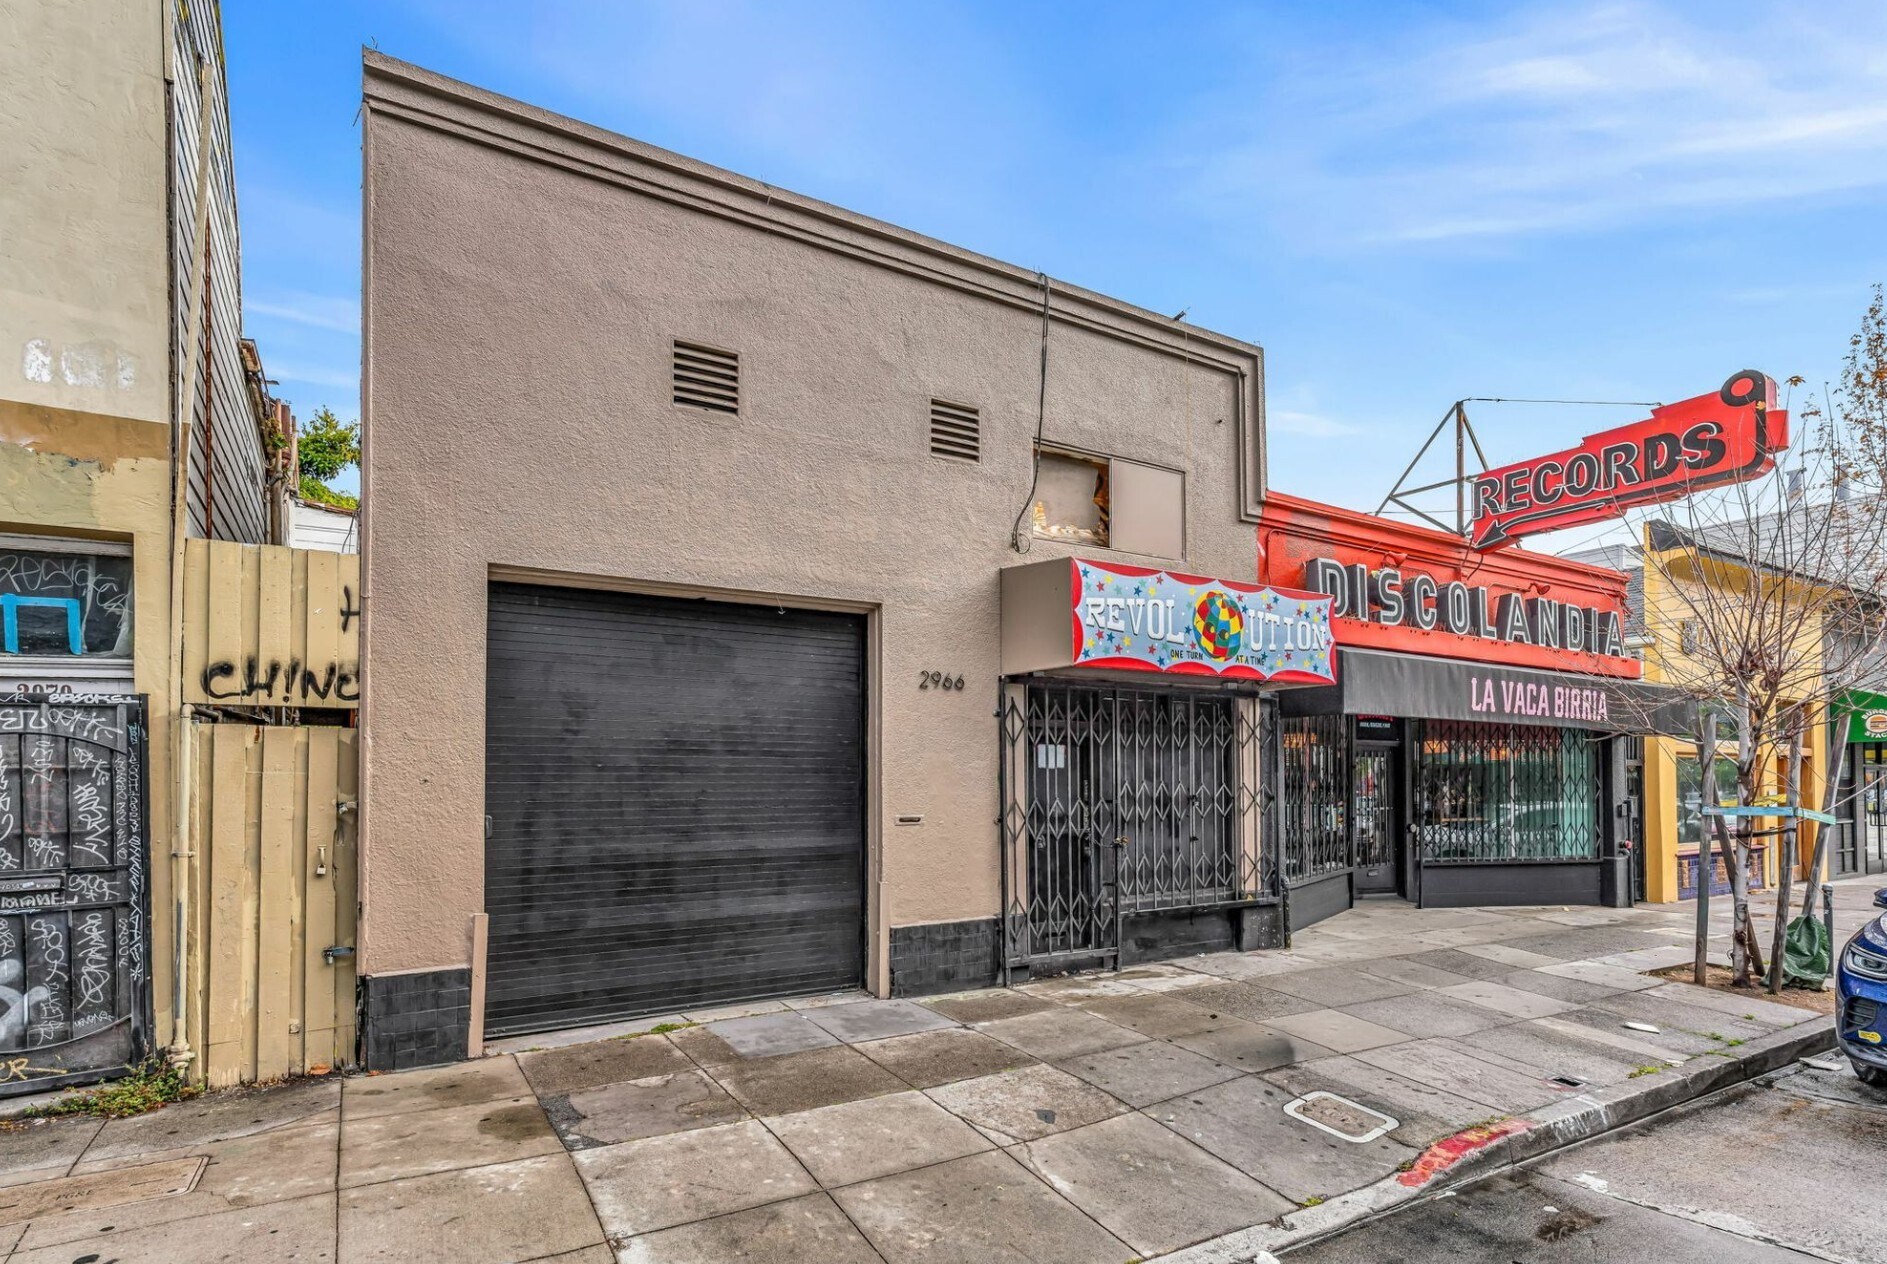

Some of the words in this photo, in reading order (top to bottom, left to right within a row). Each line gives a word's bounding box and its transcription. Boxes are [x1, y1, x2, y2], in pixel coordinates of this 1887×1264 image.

[1470, 421, 1727, 521] RECORDS
[1310, 556, 1626, 657] DISCOLANDIA
[1170, 648, 1184, 659] ONE
[1186, 650, 1204, 661] TURN
[1235, 655, 1243, 664] AT
[1250, 656, 1265, 667] TIME
[919, 670, 966, 691] 2966
[1471, 677, 1496, 713] LA
[1501, 680, 1550, 716] VACA
[1554, 686, 1608, 722] BIRRIA
